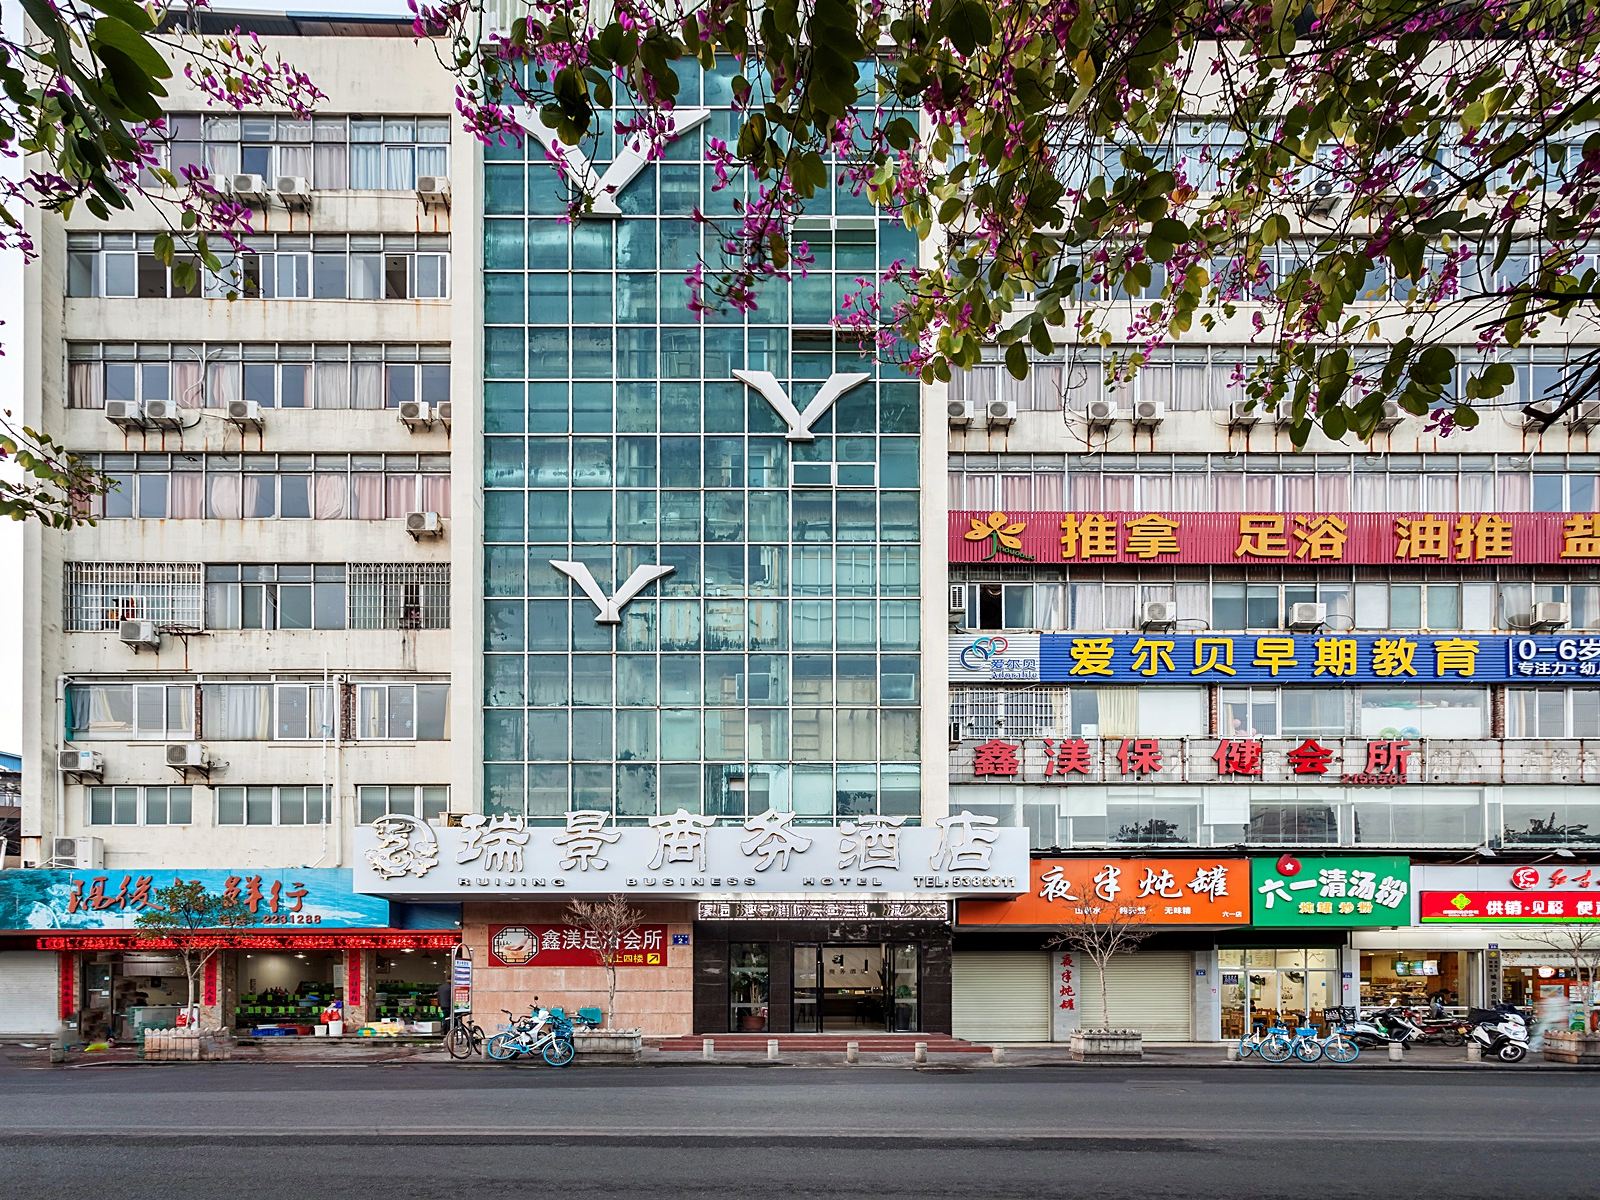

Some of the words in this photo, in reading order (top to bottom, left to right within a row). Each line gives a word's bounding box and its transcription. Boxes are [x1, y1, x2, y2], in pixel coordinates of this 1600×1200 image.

[1060, 513, 1181, 559] 推拿
[1233, 513, 1348, 560] 足浴
[1395, 513, 1513, 560] 油推
[1069, 637, 1480, 677] 爱尔贝早期教育
[455, 808, 1001, 873] 瑞景商务酒店
[457, 877, 567, 887] RUIJING
[625, 877, 757, 887] BUSINESS
[803, 876, 884, 887] HOTEL
[1257, 868, 1409, 909] 六一清汤粉
[1164, 906, 1192, 915] 无味精
